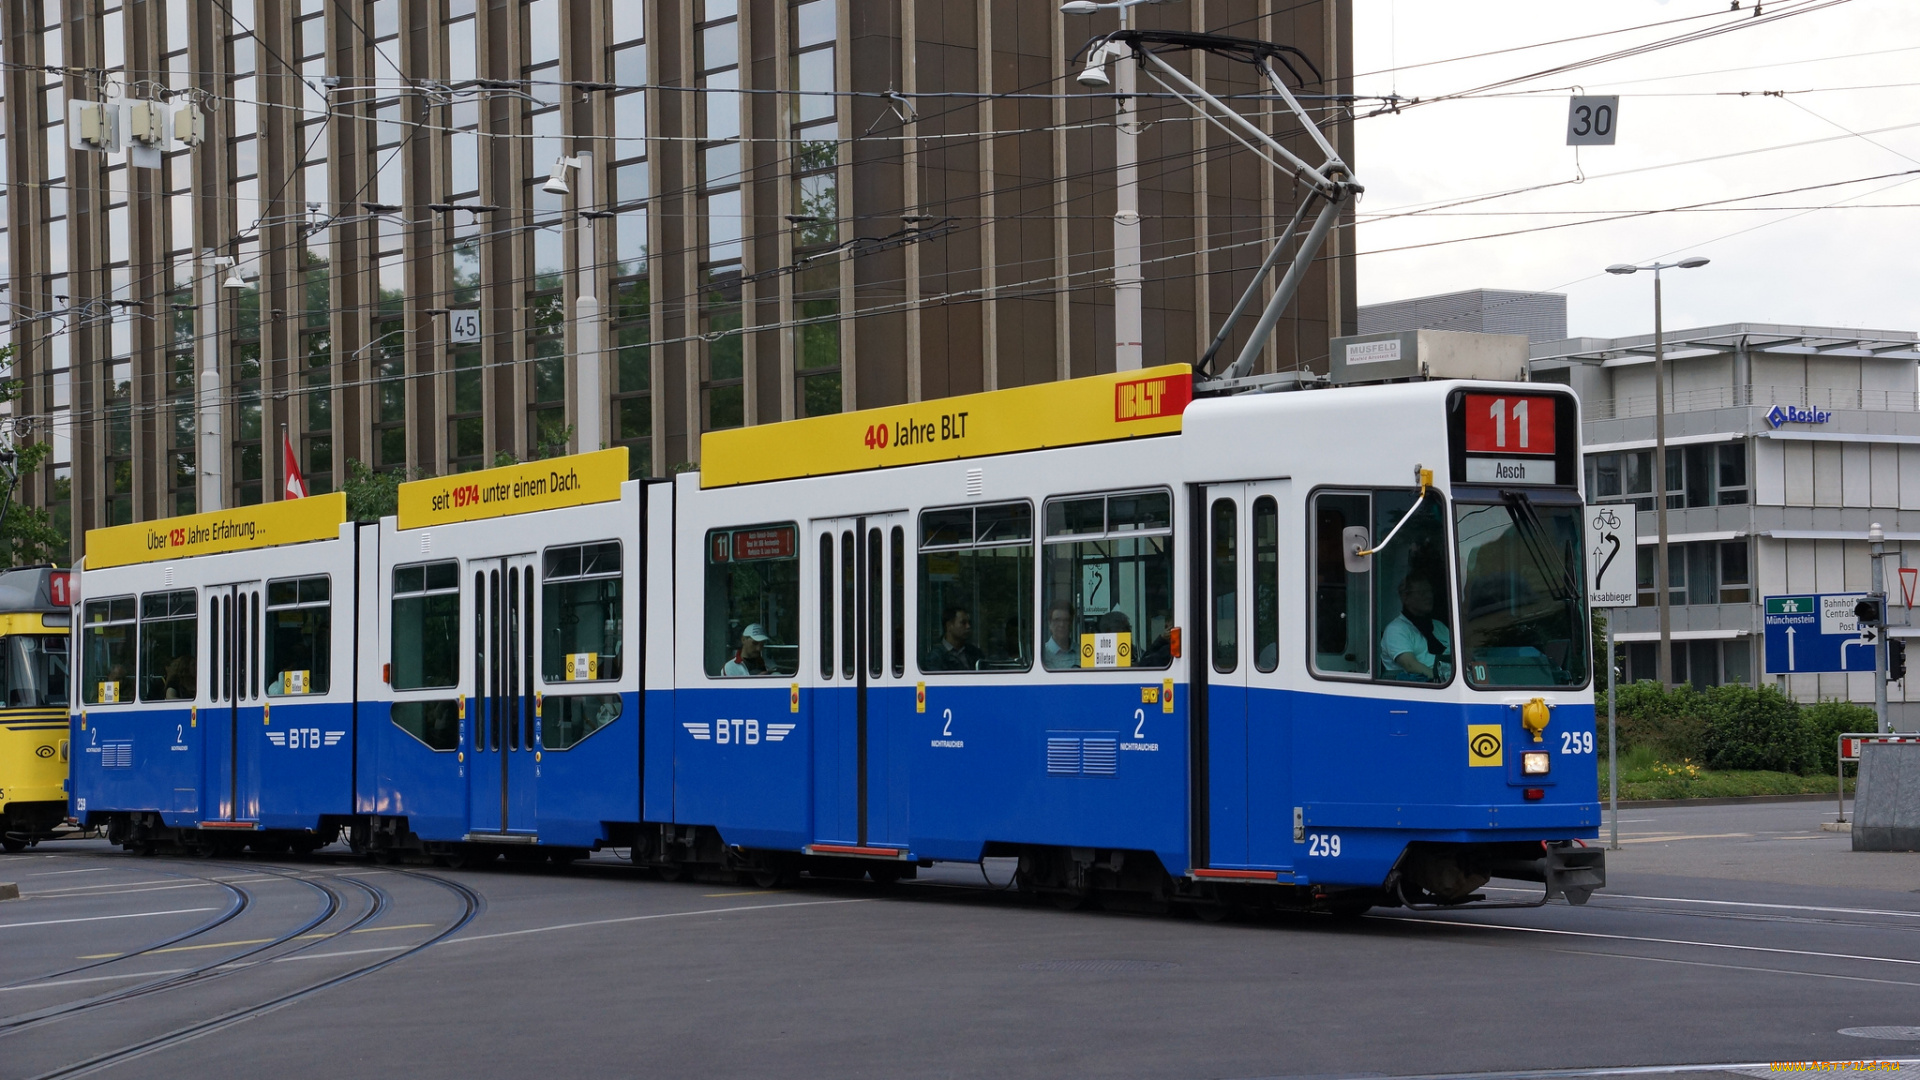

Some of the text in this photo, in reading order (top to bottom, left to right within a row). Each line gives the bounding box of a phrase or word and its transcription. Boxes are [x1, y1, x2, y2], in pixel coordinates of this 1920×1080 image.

[1573, 104, 1612, 136] 30
[454, 316, 476, 337] 45
[1350, 342, 1397, 355] MUSFELD
[1118, 379, 1166, 419] BLT
[1490, 398, 1528, 448] 11
[1787, 405, 1832, 423] Basler
[864, 412, 969, 450] 40 Jahre BLT
[1495, 462, 1526, 480] Aesch
[432, 467, 581, 511] seit 1974 unter einem Dach.
[147, 529, 168, 550] Über
[169, 528, 186, 547] 125
[187, 525, 210, 545] Jahre
[717, 536, 728, 557] 11
[1824, 598, 1854, 608] Bahnhof
[1766, 614, 1815, 625] Münchenstein
[1839, 622, 1855, 631] Post
[1474, 665, 1486, 681] 10
[716, 719, 760, 745] BTB
[943, 708, 953, 736] 2
[1133, 708, 1145, 739] 2
[91, 727, 97, 746] 2
[176, 723, 183, 743] 2
[289, 728, 321, 749] BTB
[1561, 731, 1593, 754] 259
[1120, 742, 1159, 752] NICHTRAUCHER
[1309, 833, 1341, 857] 259
